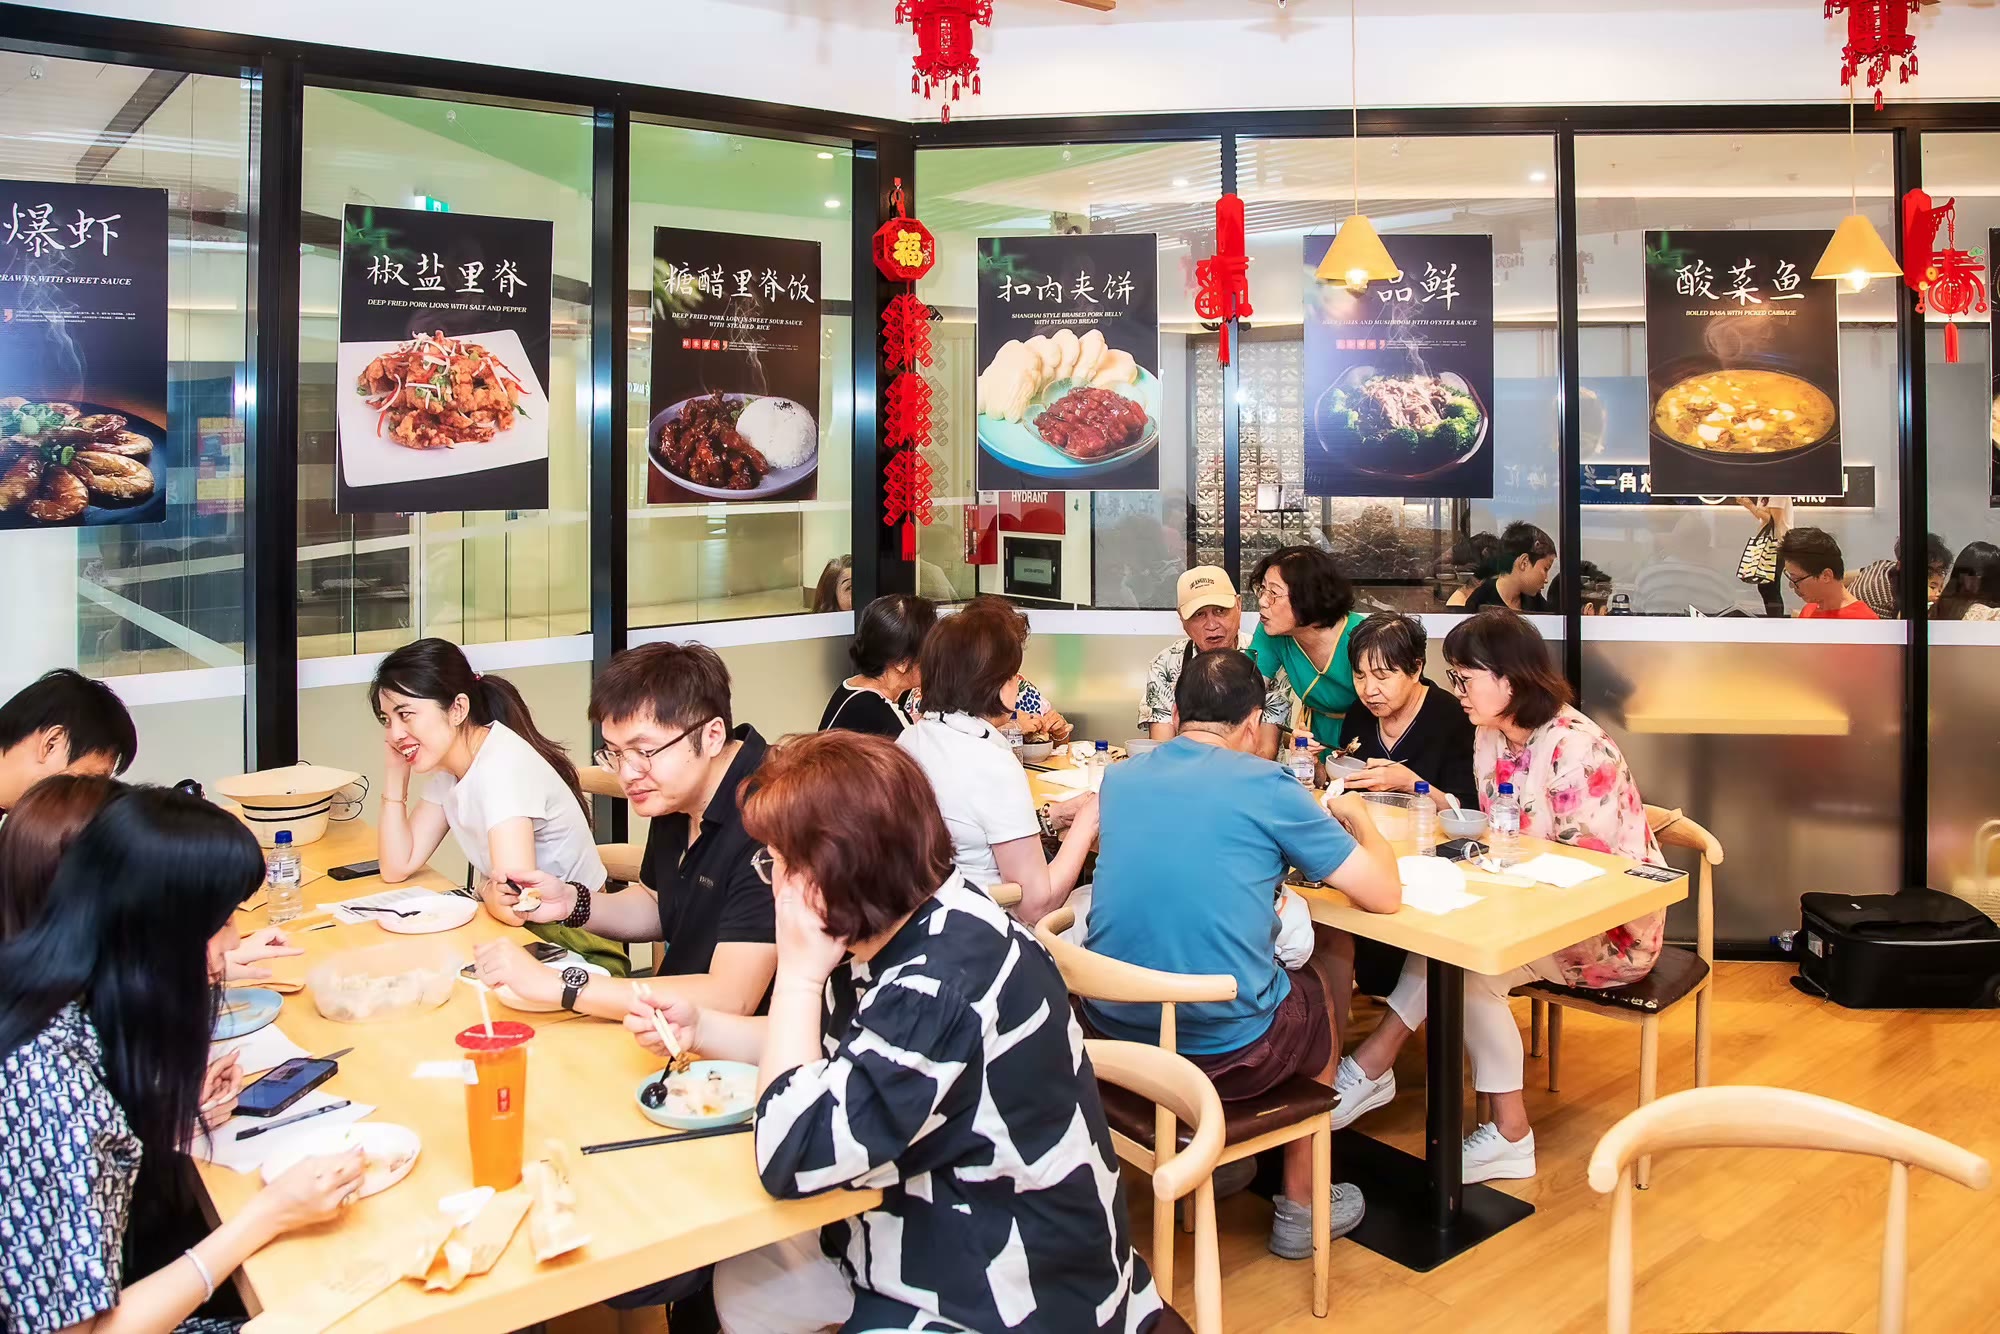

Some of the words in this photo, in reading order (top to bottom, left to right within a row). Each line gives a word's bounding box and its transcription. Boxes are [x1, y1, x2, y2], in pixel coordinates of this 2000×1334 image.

[3, 202, 122, 257] 爆虾
[893, 229, 923, 267] 福
[38, 275, 64, 283] WITH
[65, 276, 100, 285] SWEET
[100, 277, 132, 286] SAUCE
[366, 252, 528, 299] 椒盐里脊
[662, 261, 815, 304] 糖醋里脊饭
[996, 270, 1136, 306] 扣肉夹饼
[1675, 257, 1805, 306] 酸菜鱼
[1011, 491, 1049, 504] HYDRANT
